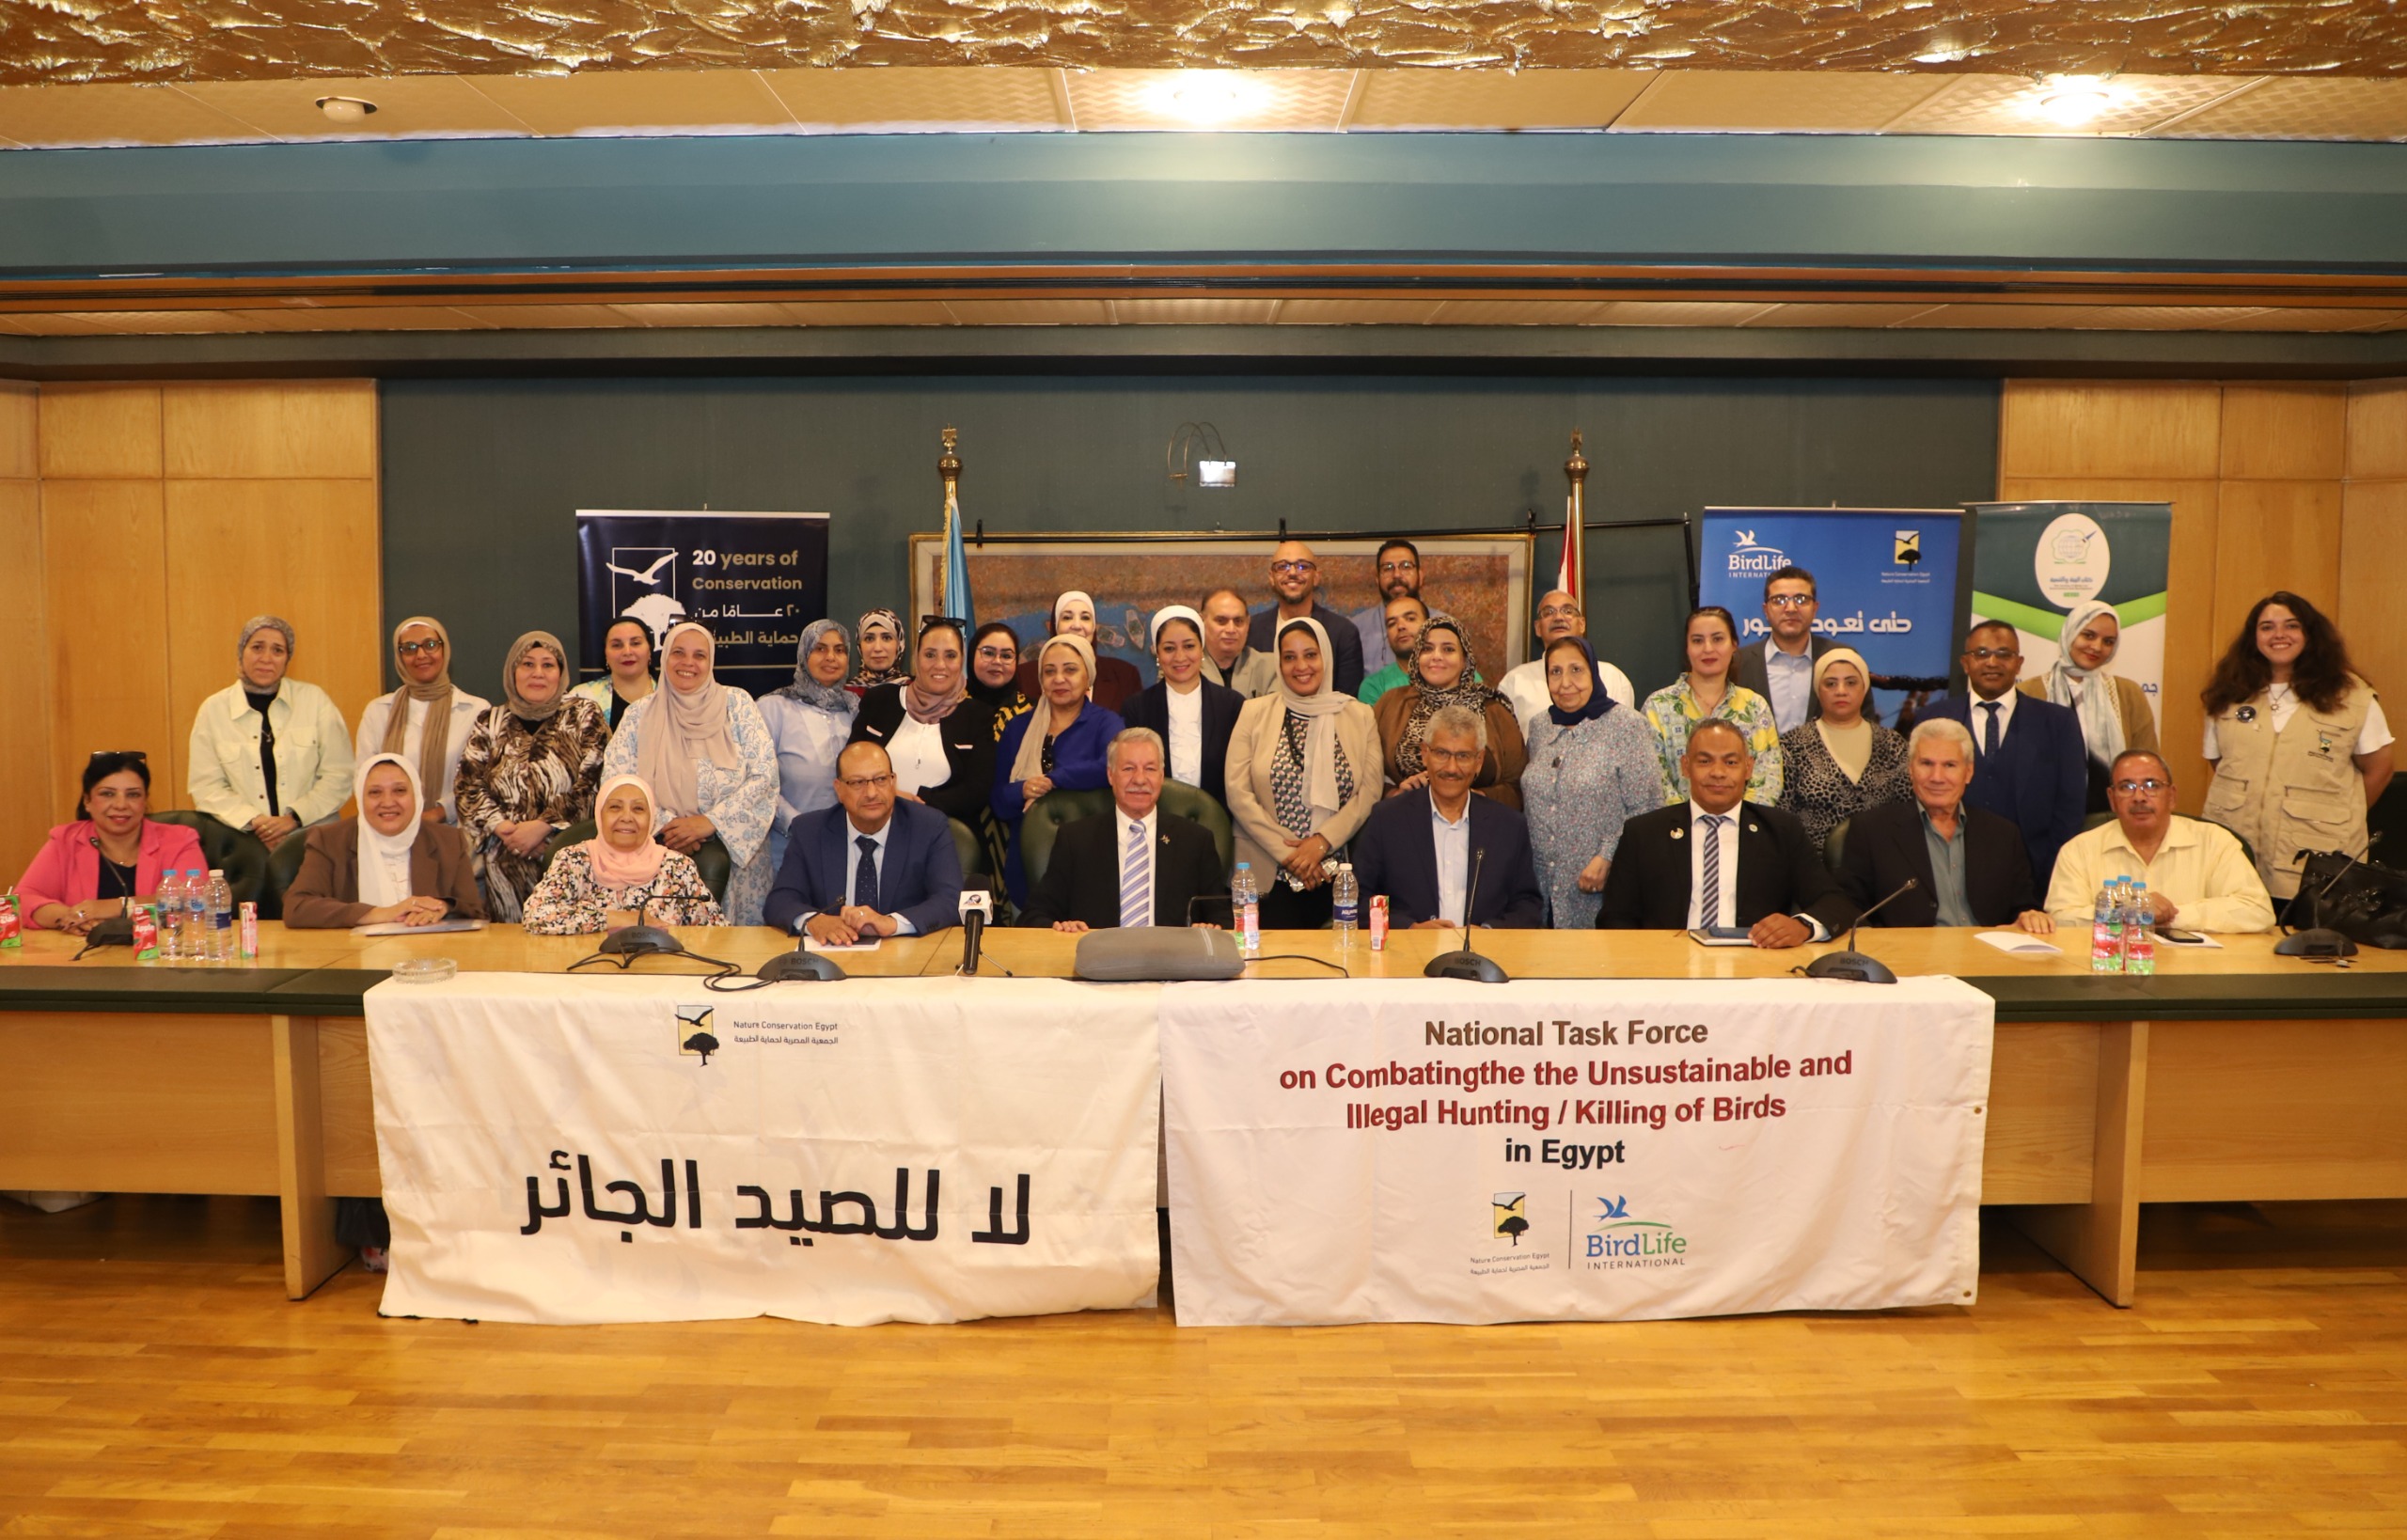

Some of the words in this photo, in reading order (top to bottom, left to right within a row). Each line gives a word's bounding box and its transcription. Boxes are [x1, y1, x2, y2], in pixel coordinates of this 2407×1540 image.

[692, 549, 716, 566] 20
[719, 553, 776, 571] years
[779, 550, 798, 566] of
[1728, 555, 1792, 571] BirdLife
[692, 575, 802, 590] Conservation
[1868, 610, 1912, 633] حتى
[757, 630, 799, 648] حماية
[733, 1020, 760, 1029] Nature
[761, 1020, 813, 1030] Conservation
[814, 1022, 838, 1032] Egypt
[1425, 1020, 1544, 1046] National
[1551, 1020, 1619, 1046] Task
[1628, 1019, 1708, 1045] Force
[760, 1035, 782, 1045] لحماية
[783, 1036, 810, 1045] المصرية
[810, 1037, 839, 1045] الجمعية
[1279, 1070, 1316, 1090] on
[1325, 1060, 1525, 1093] Combatingthe
[1533, 1061, 1579, 1086] the
[1588, 1053, 1791, 1086] Unsustainable
[1799, 1049, 1852, 1077] and
[1346, 1099, 1427, 1132] Illegal
[1438, 1098, 1550, 1131] Hunting
[1557, 1099, 1568, 1125] /
[1575, 1099, 1667, 1131] Killing
[1675, 1096, 1706, 1123] of
[1713, 1092, 1787, 1123] Birds
[1505, 1138, 1532, 1163] in
[1541, 1139, 1626, 1171] Egypt
[519, 1149, 702, 1244] الجائر
[734, 1167, 940, 1248] للصيد
[971, 1173, 1030, 1246] لا
[1585, 1232, 1687, 1257] BirdLife
[1491, 1253, 1532, 1263] Conservation
[1586, 1259, 1687, 1270] INTERNATIONAL
